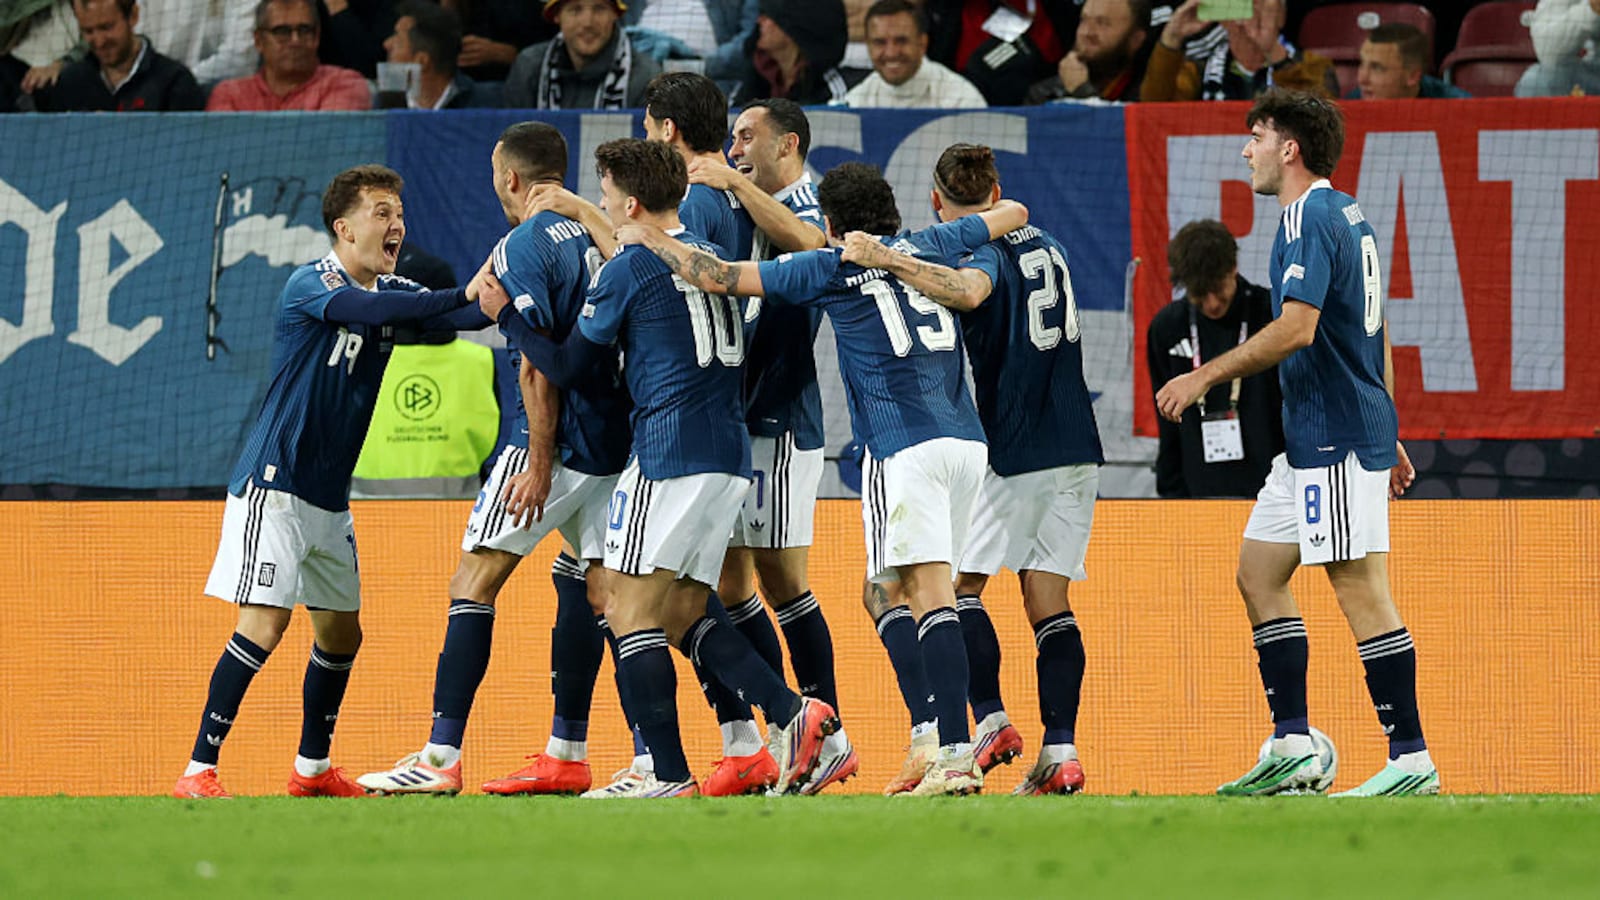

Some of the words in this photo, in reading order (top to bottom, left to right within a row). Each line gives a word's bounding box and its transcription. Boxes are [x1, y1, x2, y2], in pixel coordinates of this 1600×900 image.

[671, 272, 745, 368] 10
[1018, 246, 1081, 351] 21
[1360, 233, 1383, 337] 8
[327, 326, 364, 376] 19
[1304, 484, 1321, 524] 8
